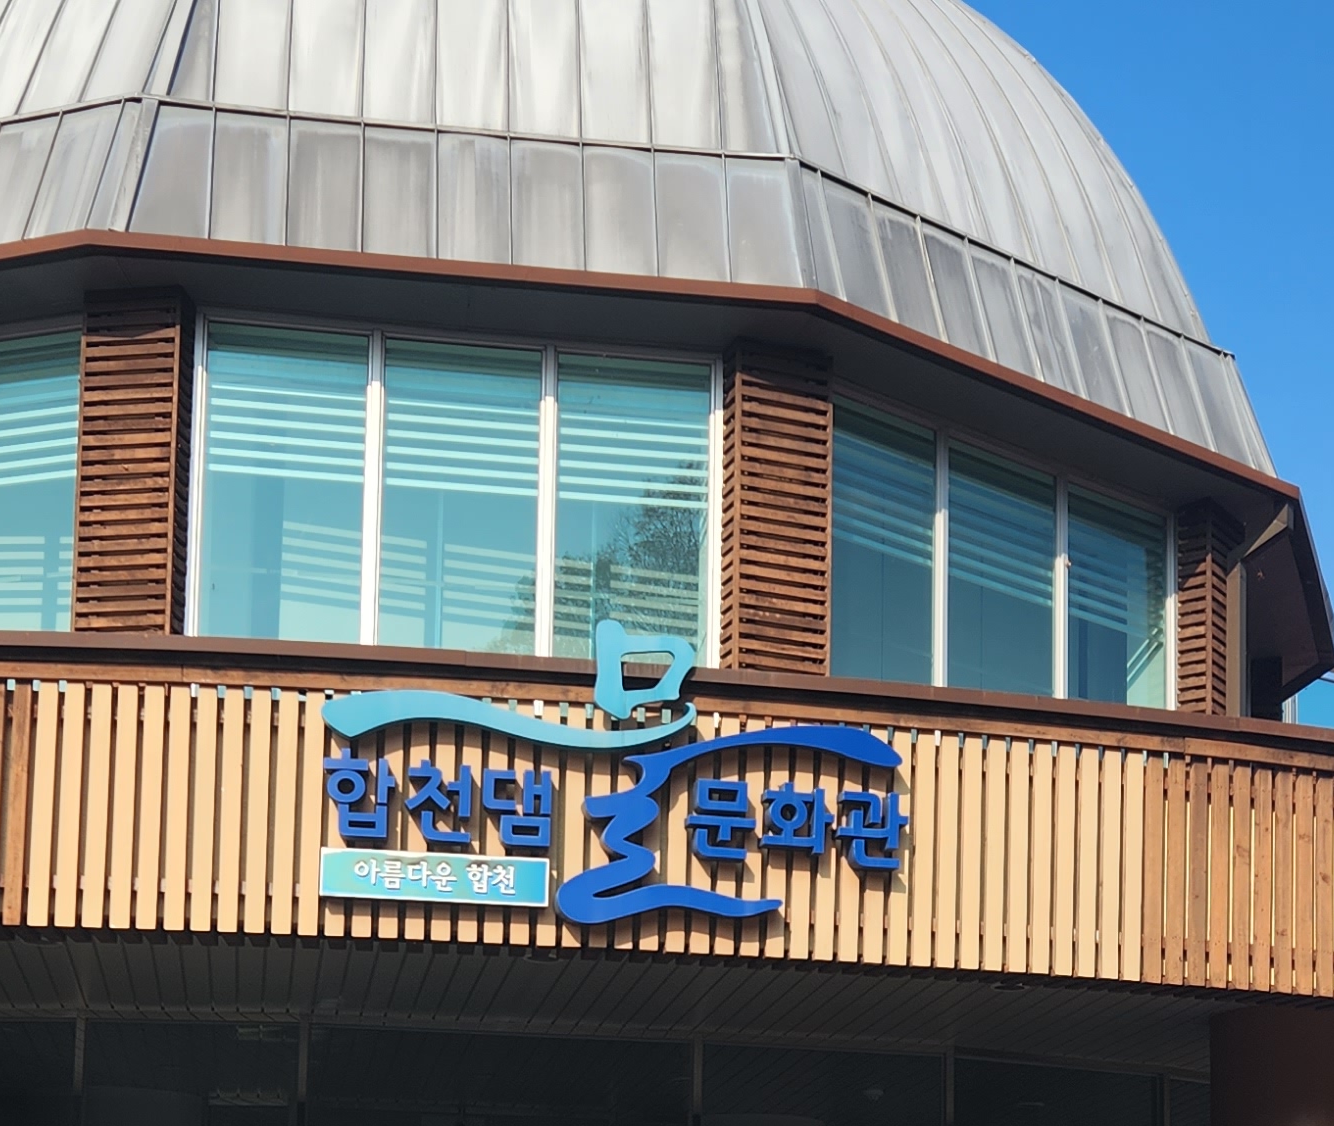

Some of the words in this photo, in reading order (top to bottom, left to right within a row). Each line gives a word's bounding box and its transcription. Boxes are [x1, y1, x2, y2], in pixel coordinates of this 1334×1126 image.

[323, 747, 554, 849] 합천댐
[686, 778, 909, 871] 문화관
[354, 861, 458, 890] 아름다운
[466, 863, 516, 896] 합천
